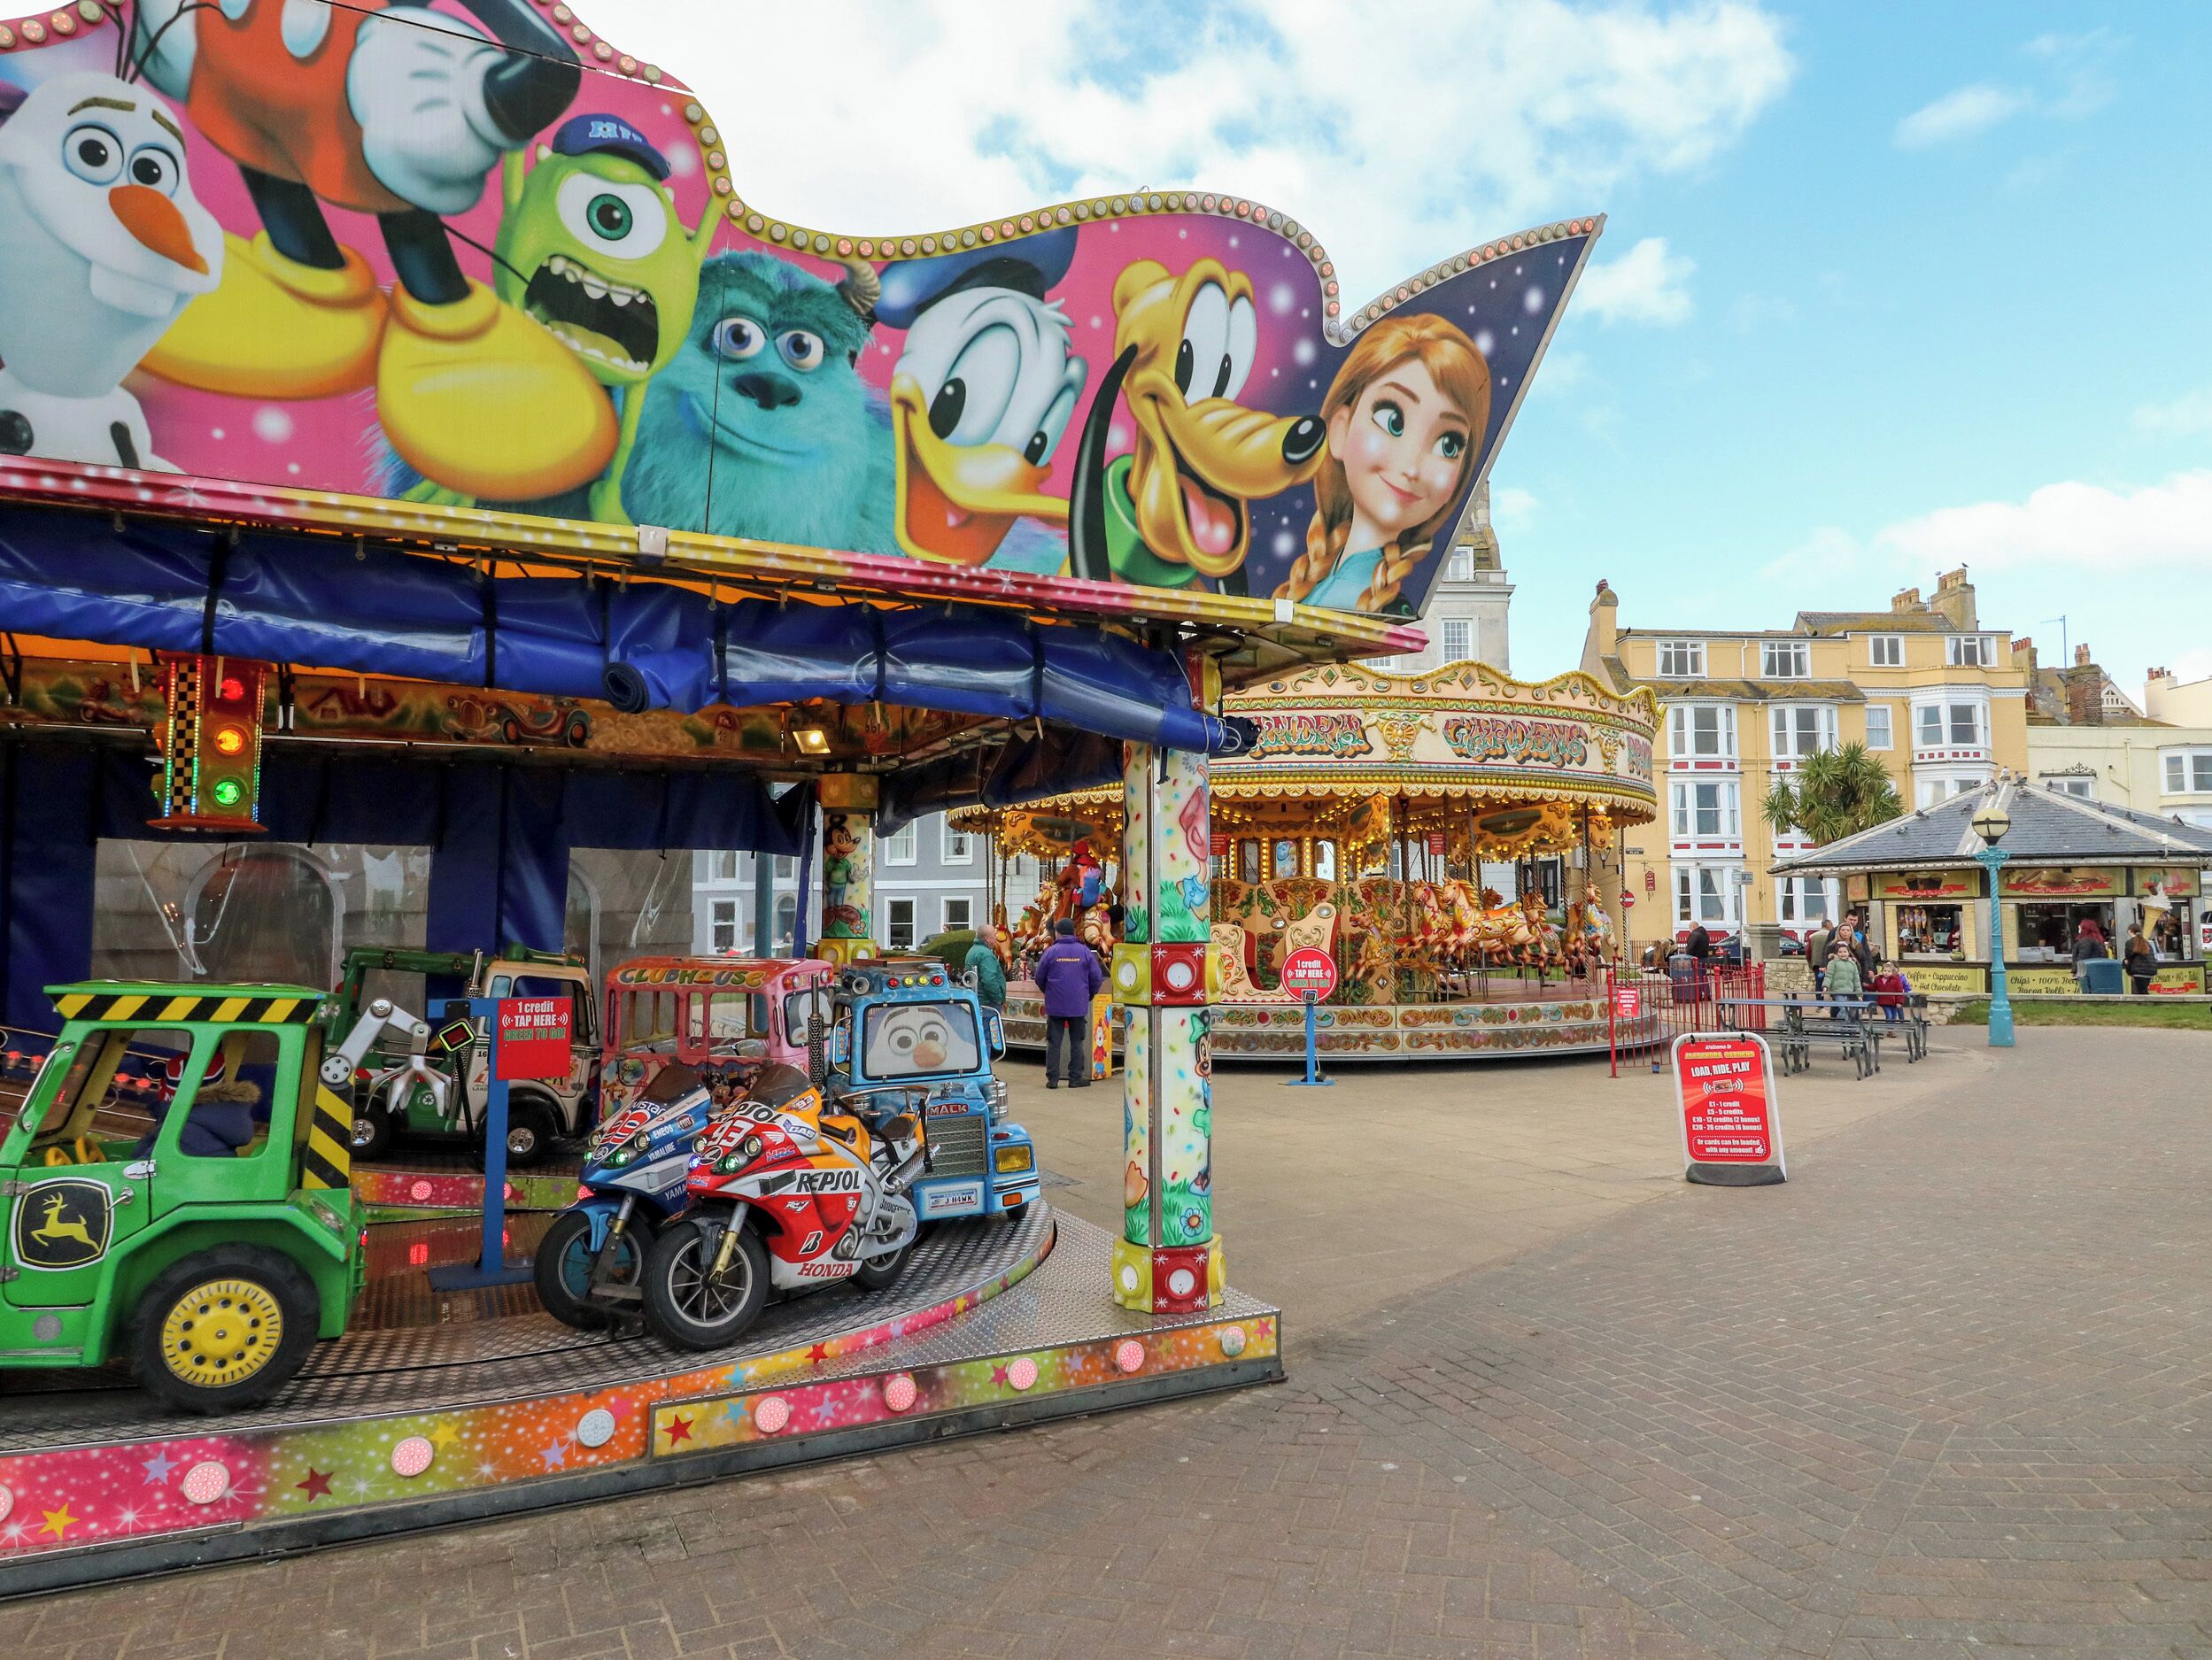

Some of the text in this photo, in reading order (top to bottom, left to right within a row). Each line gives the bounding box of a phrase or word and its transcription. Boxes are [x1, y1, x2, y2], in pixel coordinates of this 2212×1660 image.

[1247, 714, 1368, 757] ANDRA
[1296, 960, 1321, 969] 1 credit
[1295, 969, 1324, 978] TAP HERE
[1906, 972, 1968, 983] Coffee Cappuccino
[2010, 976, 2030, 985] Chips
[2038, 977, 2060, 985] 100%
[1919, 982, 1961, 992] Hot Chocolate
[517, 1000, 554, 1013] 1 credit
[514, 1014, 557, 1027] TAP HERE
[504, 1027, 567, 1041] GREEN TO GO!
[837, 1031, 847, 1056] MACK
[1690, 1062, 1751, 1077] LOAD, RIDE, PLAY
[929, 1103, 969, 1116] MACK
[652, 1124, 674, 1139] ENEOS
[707, 1119, 755, 1148] 93
[788, 1125, 816, 1139] GAS
[647, 1141, 677, 1162] YAMALUBE
[796, 1170, 861, 1193] REPSOL
[664, 1183, 687, 1201] YAMA
[798, 1262, 854, 1278] HONDA
